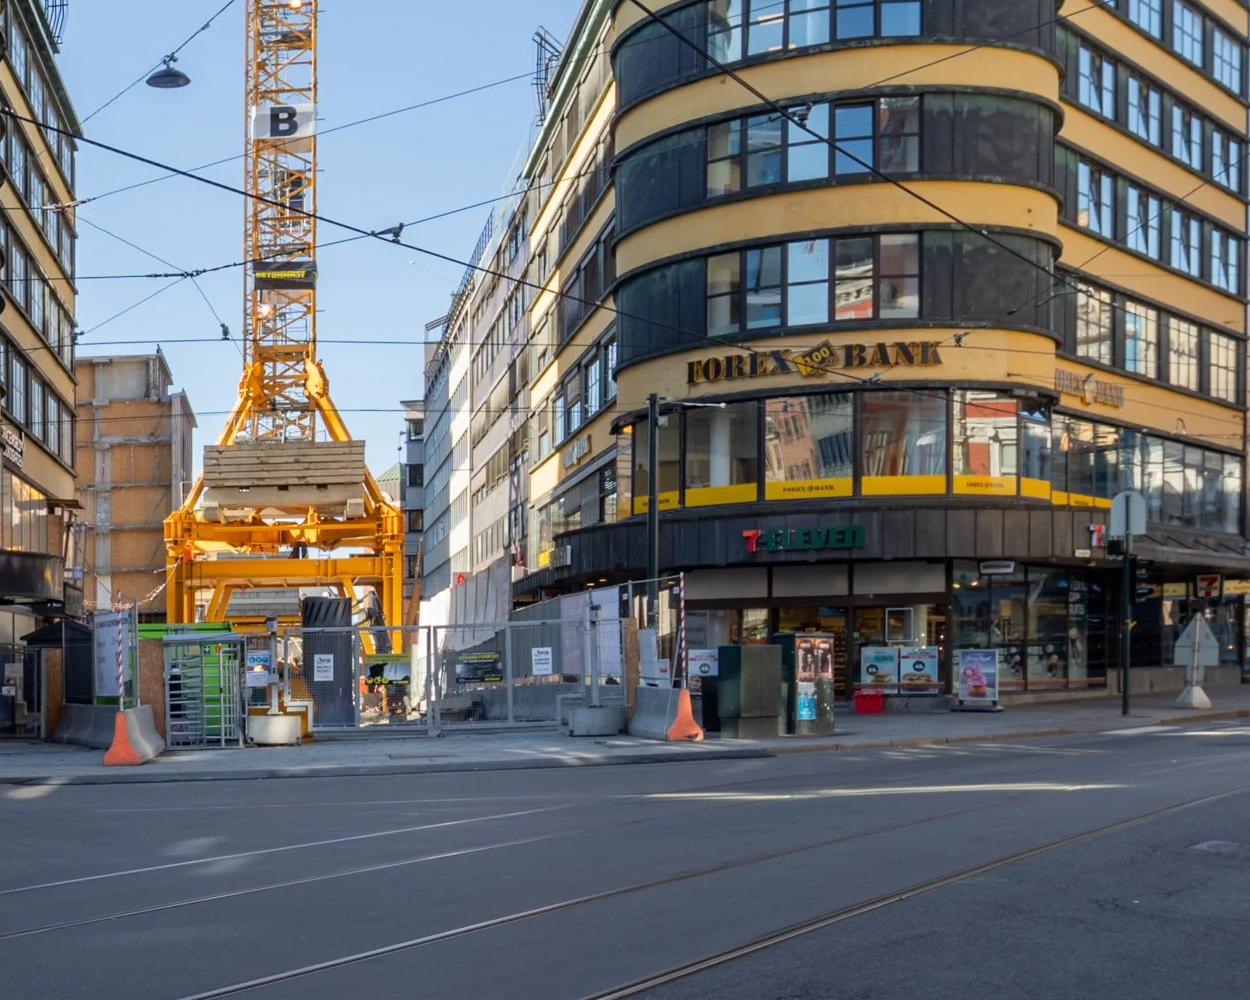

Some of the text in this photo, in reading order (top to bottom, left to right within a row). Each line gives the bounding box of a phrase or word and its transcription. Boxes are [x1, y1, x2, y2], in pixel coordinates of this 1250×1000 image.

[269, 106, 298, 137] B
[687, 349, 792, 384] FOREX
[842, 341, 943, 367] BANK
